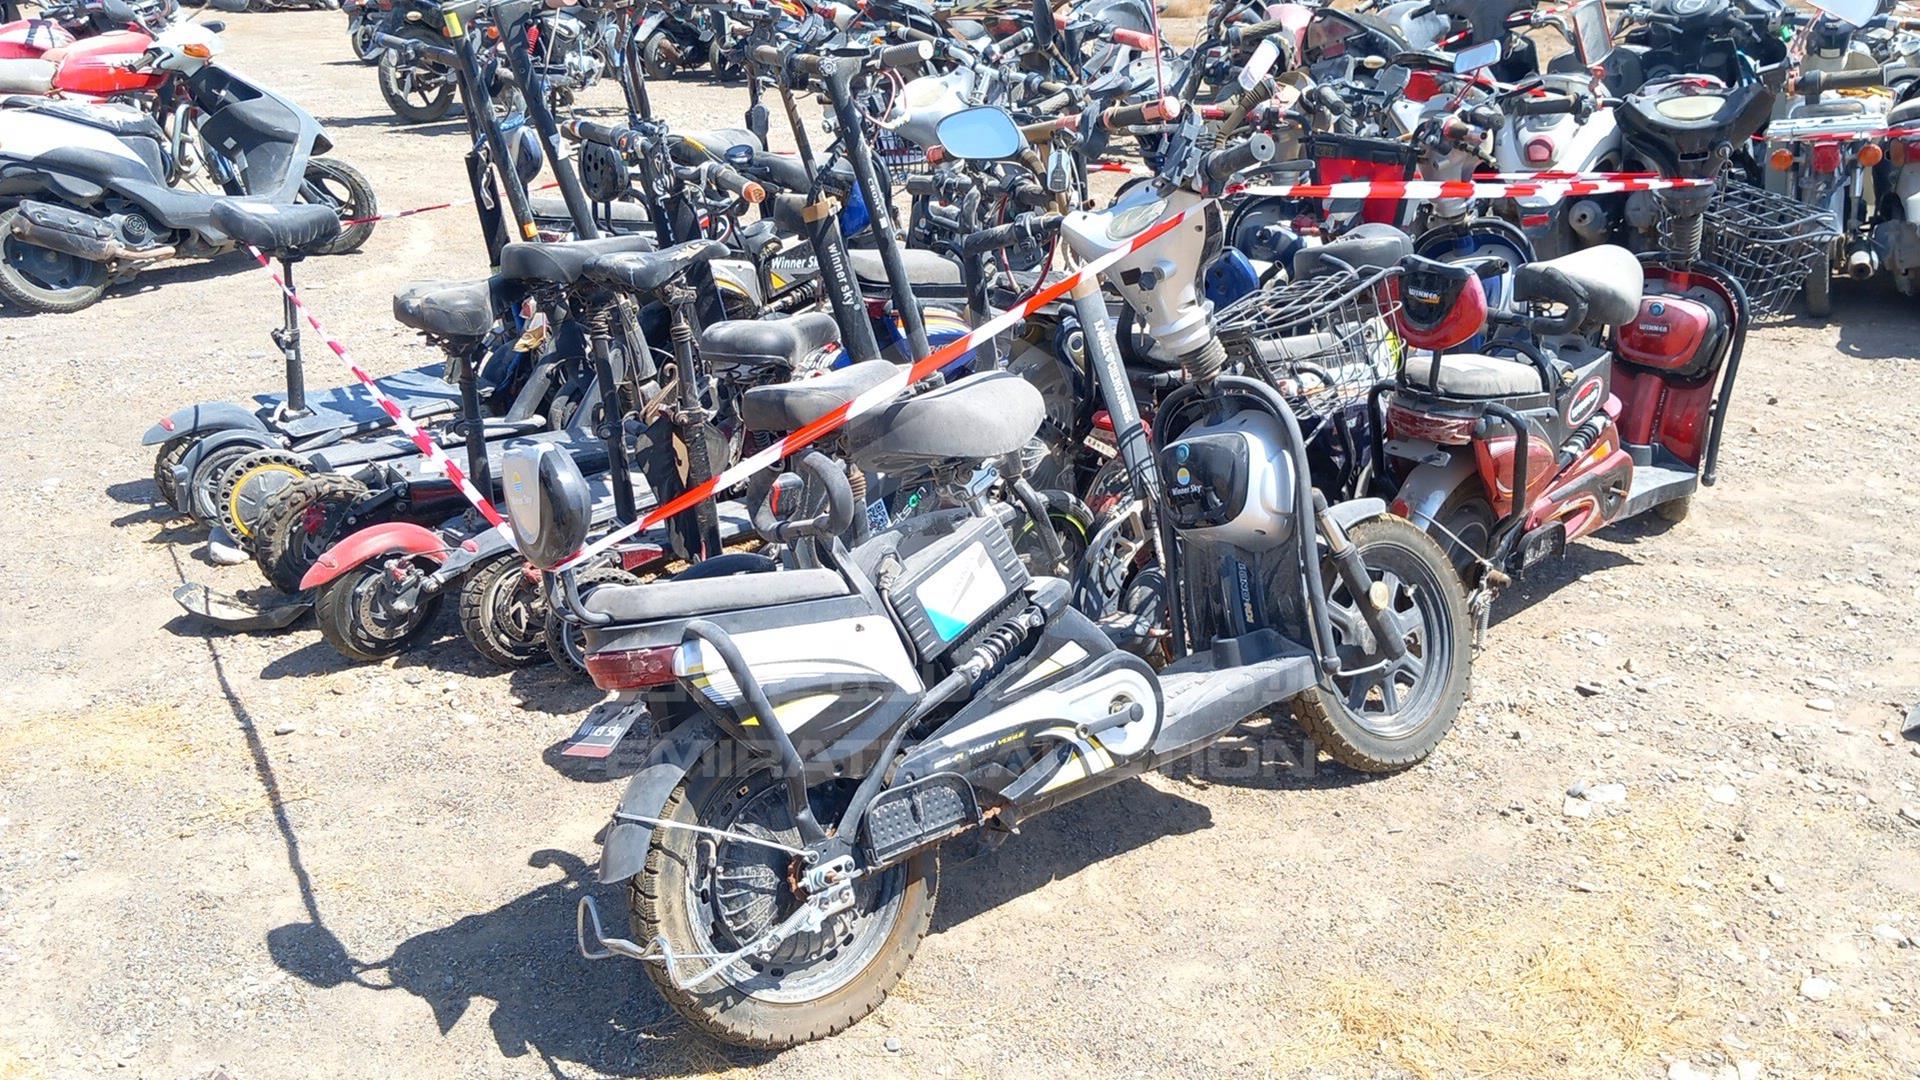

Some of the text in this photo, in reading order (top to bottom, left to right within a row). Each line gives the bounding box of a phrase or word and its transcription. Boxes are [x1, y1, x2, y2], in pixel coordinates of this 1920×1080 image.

[771, 255, 820, 269] Winner Sk
[967, 740, 999, 756] TASTY
